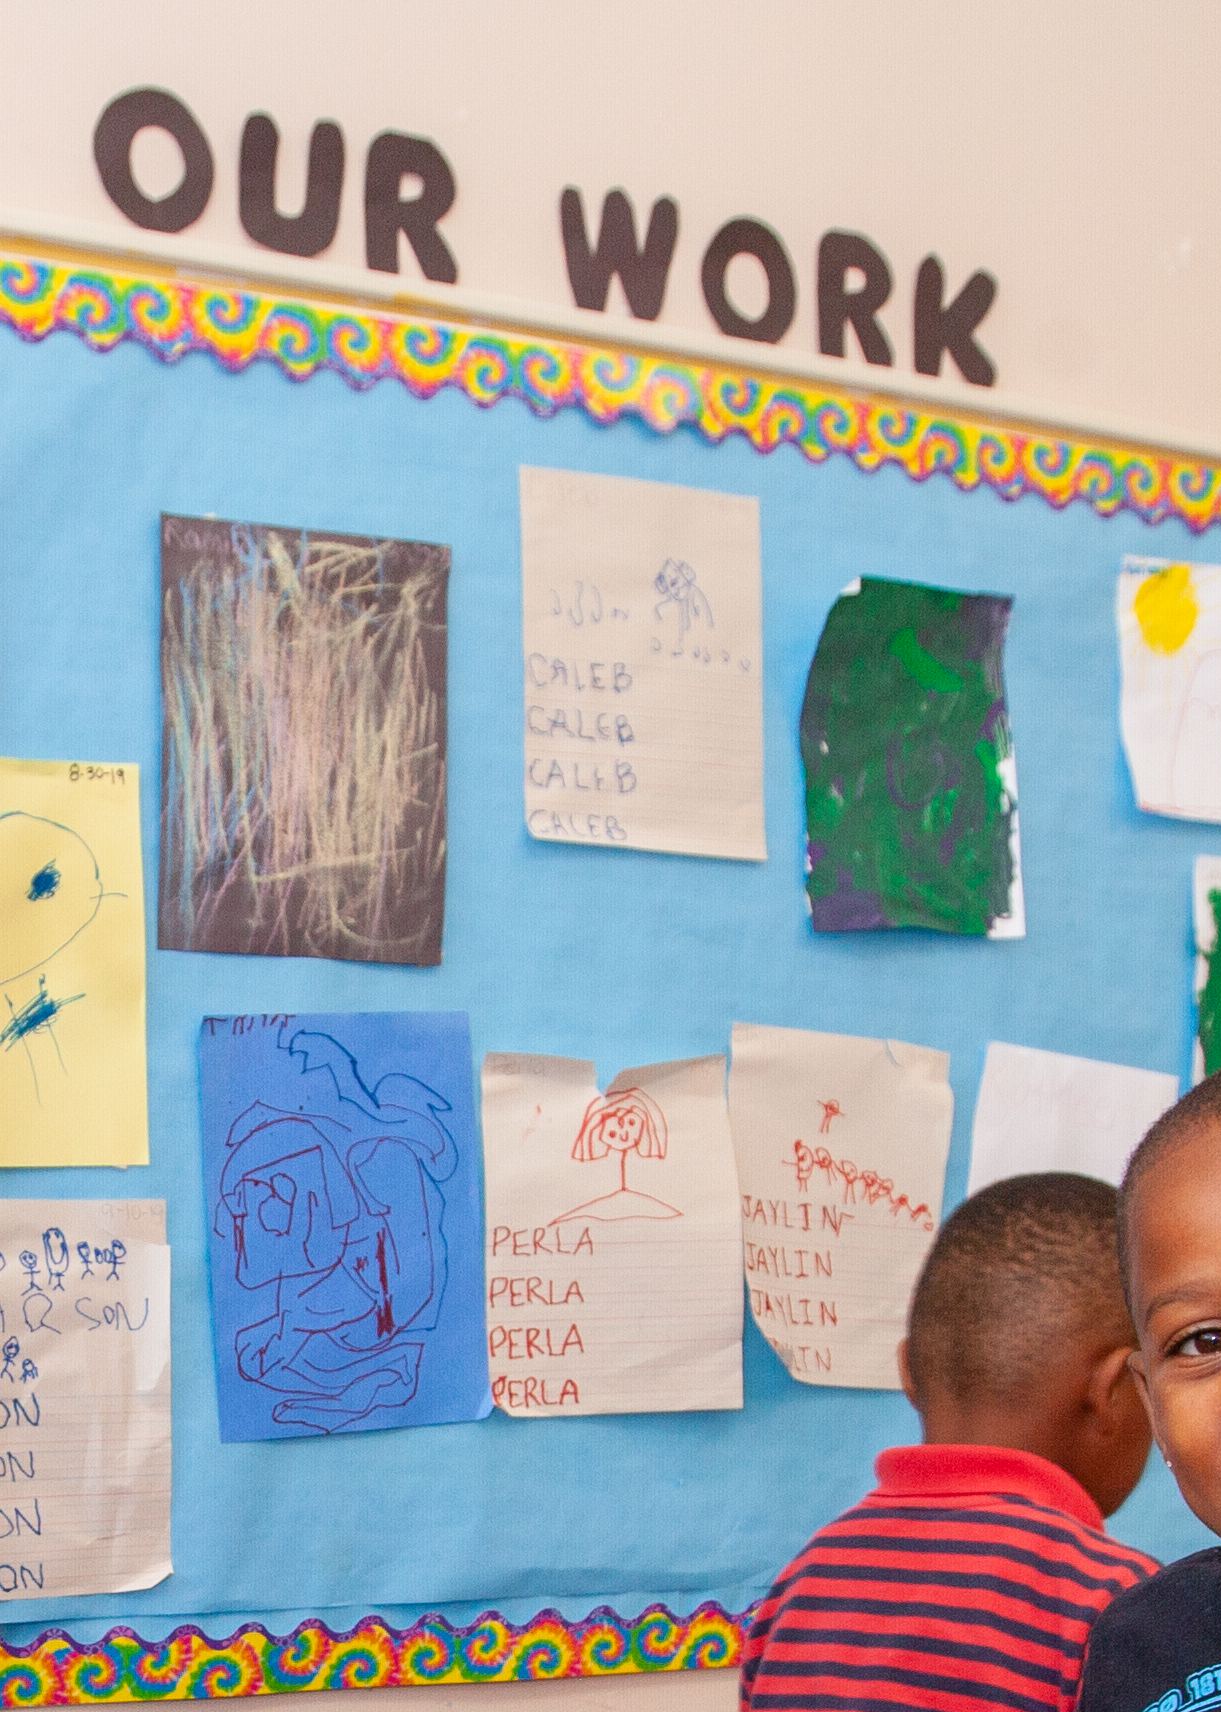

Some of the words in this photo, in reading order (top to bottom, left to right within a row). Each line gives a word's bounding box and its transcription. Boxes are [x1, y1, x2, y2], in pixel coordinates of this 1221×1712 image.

[93, 86, 459, 284] OUR
[560, 185, 998, 388] WORK
[528, 652, 633, 693] CALEB
[528, 705, 635, 746] CALEB
[69, 762, 126, 785] 8-30-19
[529, 758, 638, 793] CALEB
[529, 808, 628, 840] CALEB
[743, 1195, 849, 1236] JAYLIN
[492, 1226, 594, 1256] PERLA
[746, 1242, 832, 1278] JAYLIN
[489, 1276, 584, 1309] PERLA
[751, 1289, 838, 1328] JAYLIN
[489, 1323, 584, 1359] PERLA
[491, 1376, 580, 1408] PERLA
